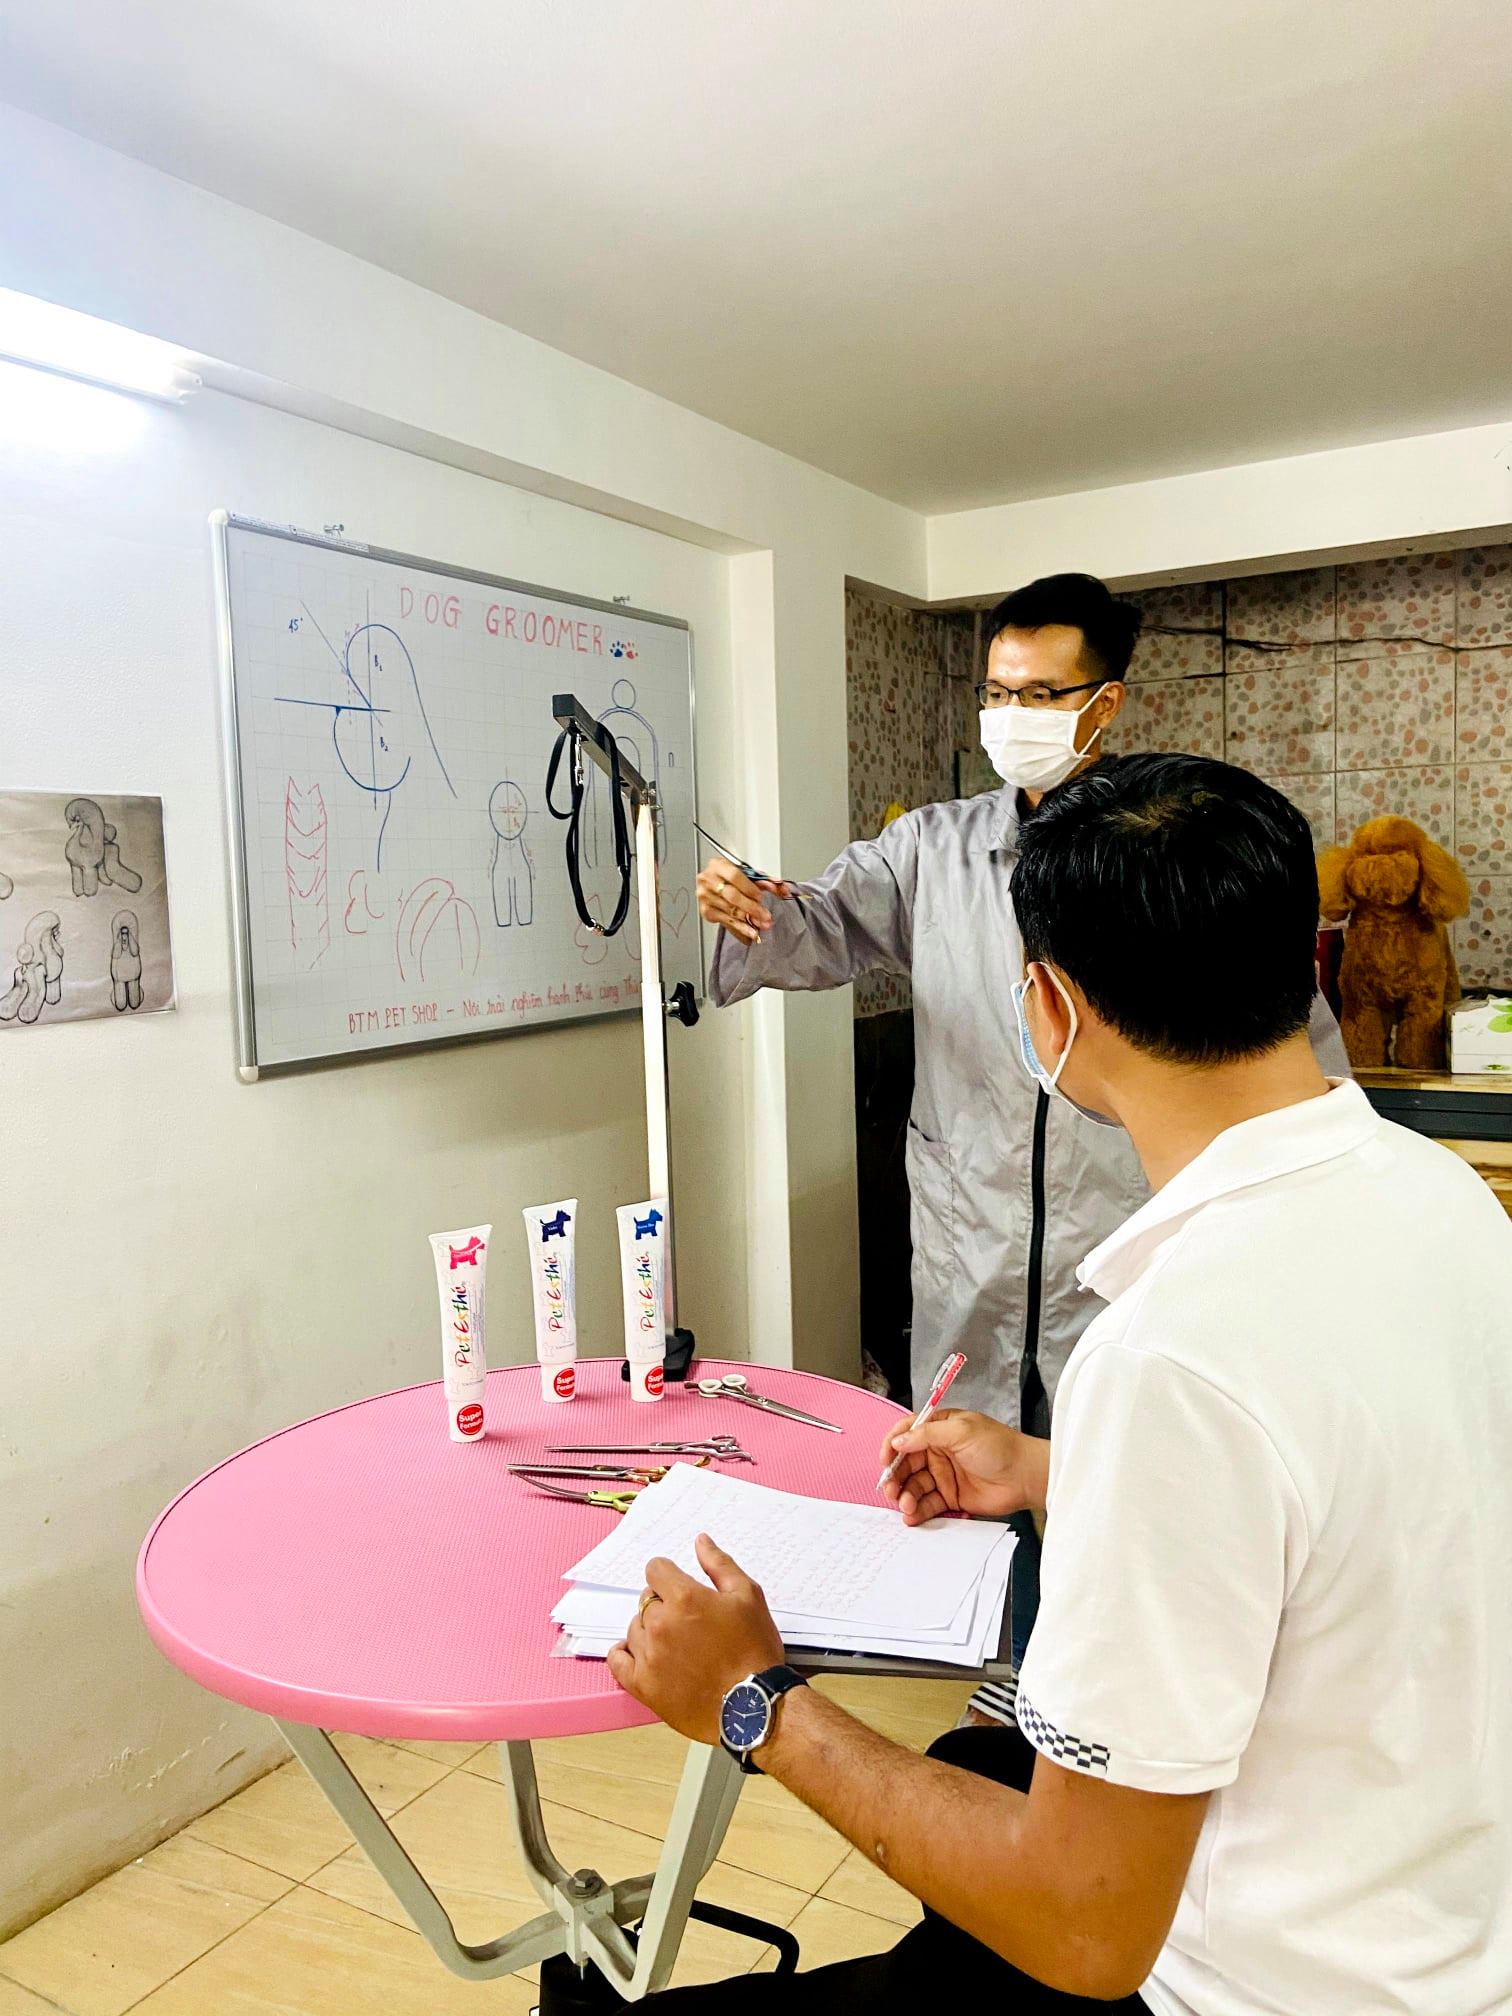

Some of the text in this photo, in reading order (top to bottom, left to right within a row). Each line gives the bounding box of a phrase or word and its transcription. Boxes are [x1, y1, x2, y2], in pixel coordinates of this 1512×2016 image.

[400, 587, 604, 656] DOG GROOMER
[348, 1010, 380, 1034] BTM
[384, 1007, 407, 1029] PET
[411, 1002, 438, 1024] SHOP
[459, 1410, 482, 1423] Super
